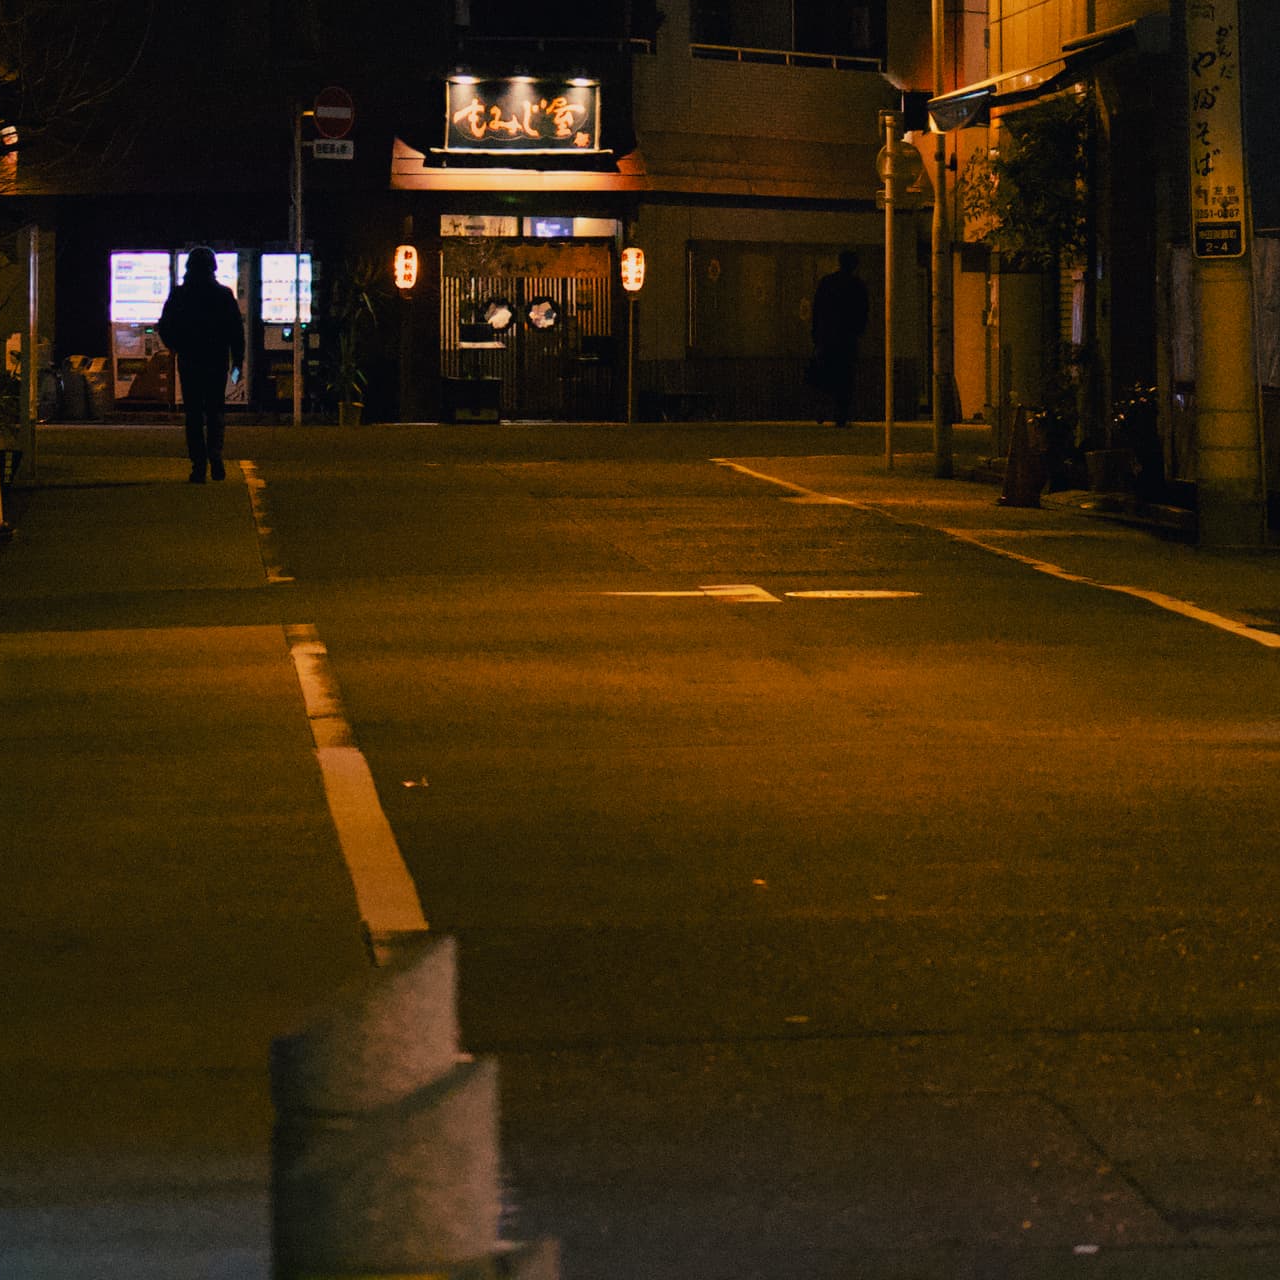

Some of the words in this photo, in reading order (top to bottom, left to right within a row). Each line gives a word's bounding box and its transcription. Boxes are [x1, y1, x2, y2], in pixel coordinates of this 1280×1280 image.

[453, 97, 586, 138] もみじ屋
[1192, 50, 1220, 177] やぶそば
